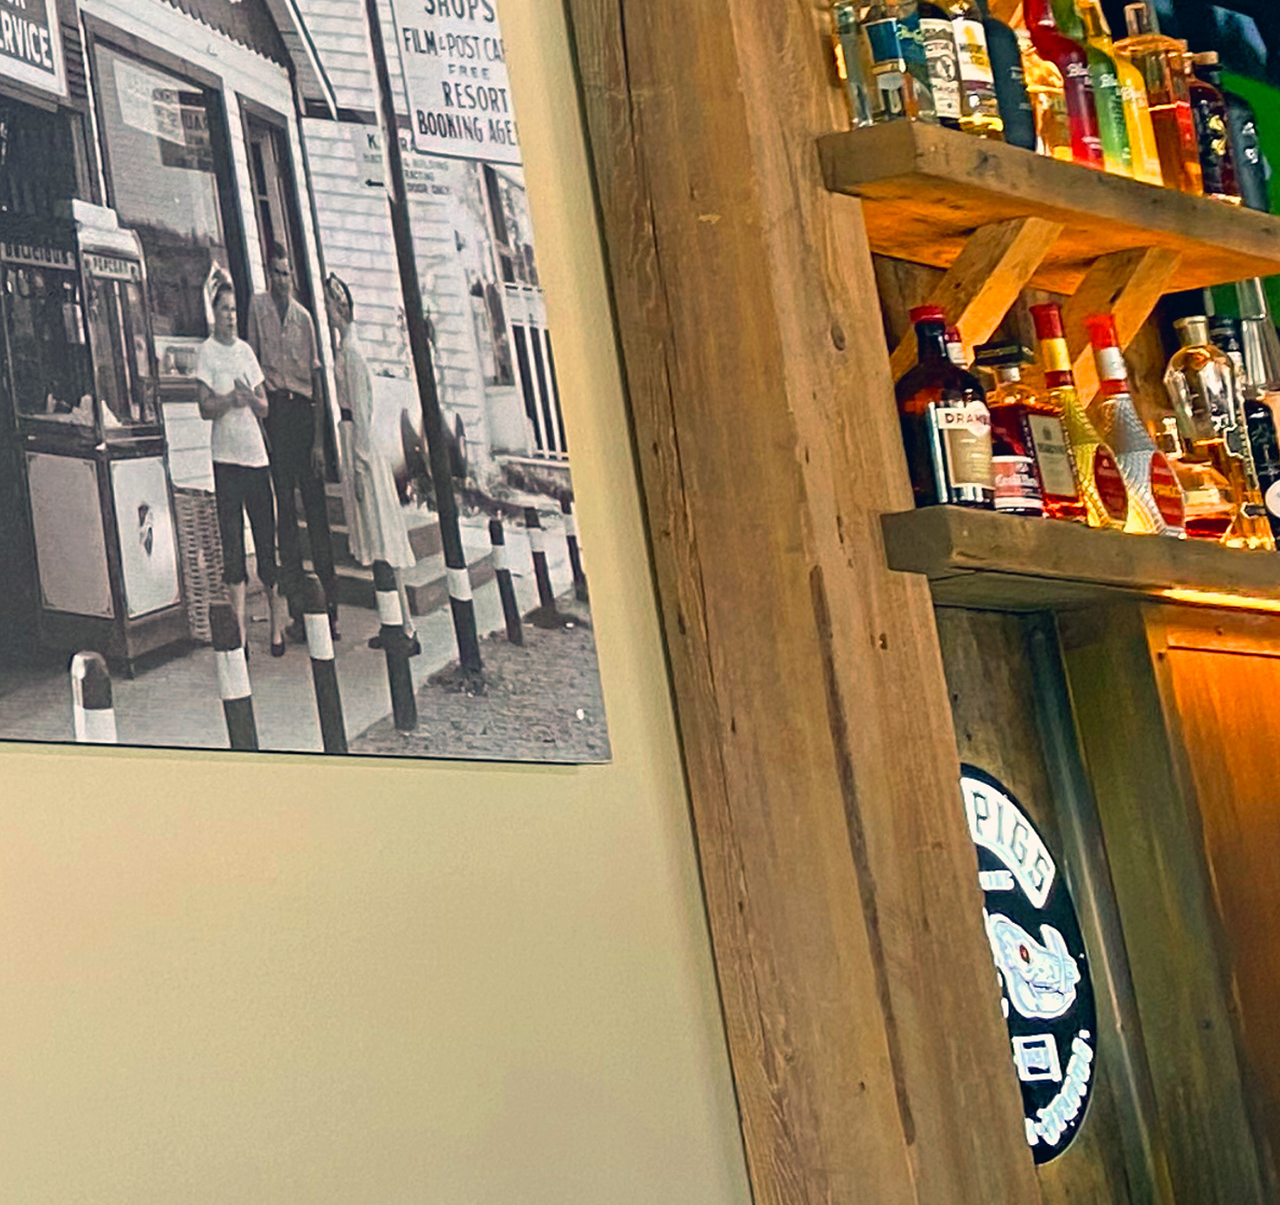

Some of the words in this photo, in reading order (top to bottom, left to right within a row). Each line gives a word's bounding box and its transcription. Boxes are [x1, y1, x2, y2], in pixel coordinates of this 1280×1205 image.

[402, 27, 438, 56] FILM
[446, 33, 480, 59] POST
[447, 63, 490, 80] FREE
[441, 81, 509, 113] RESORT
[416, 109, 483, 143] BOOKING
[971, 790, 1051, 893] PIGS
